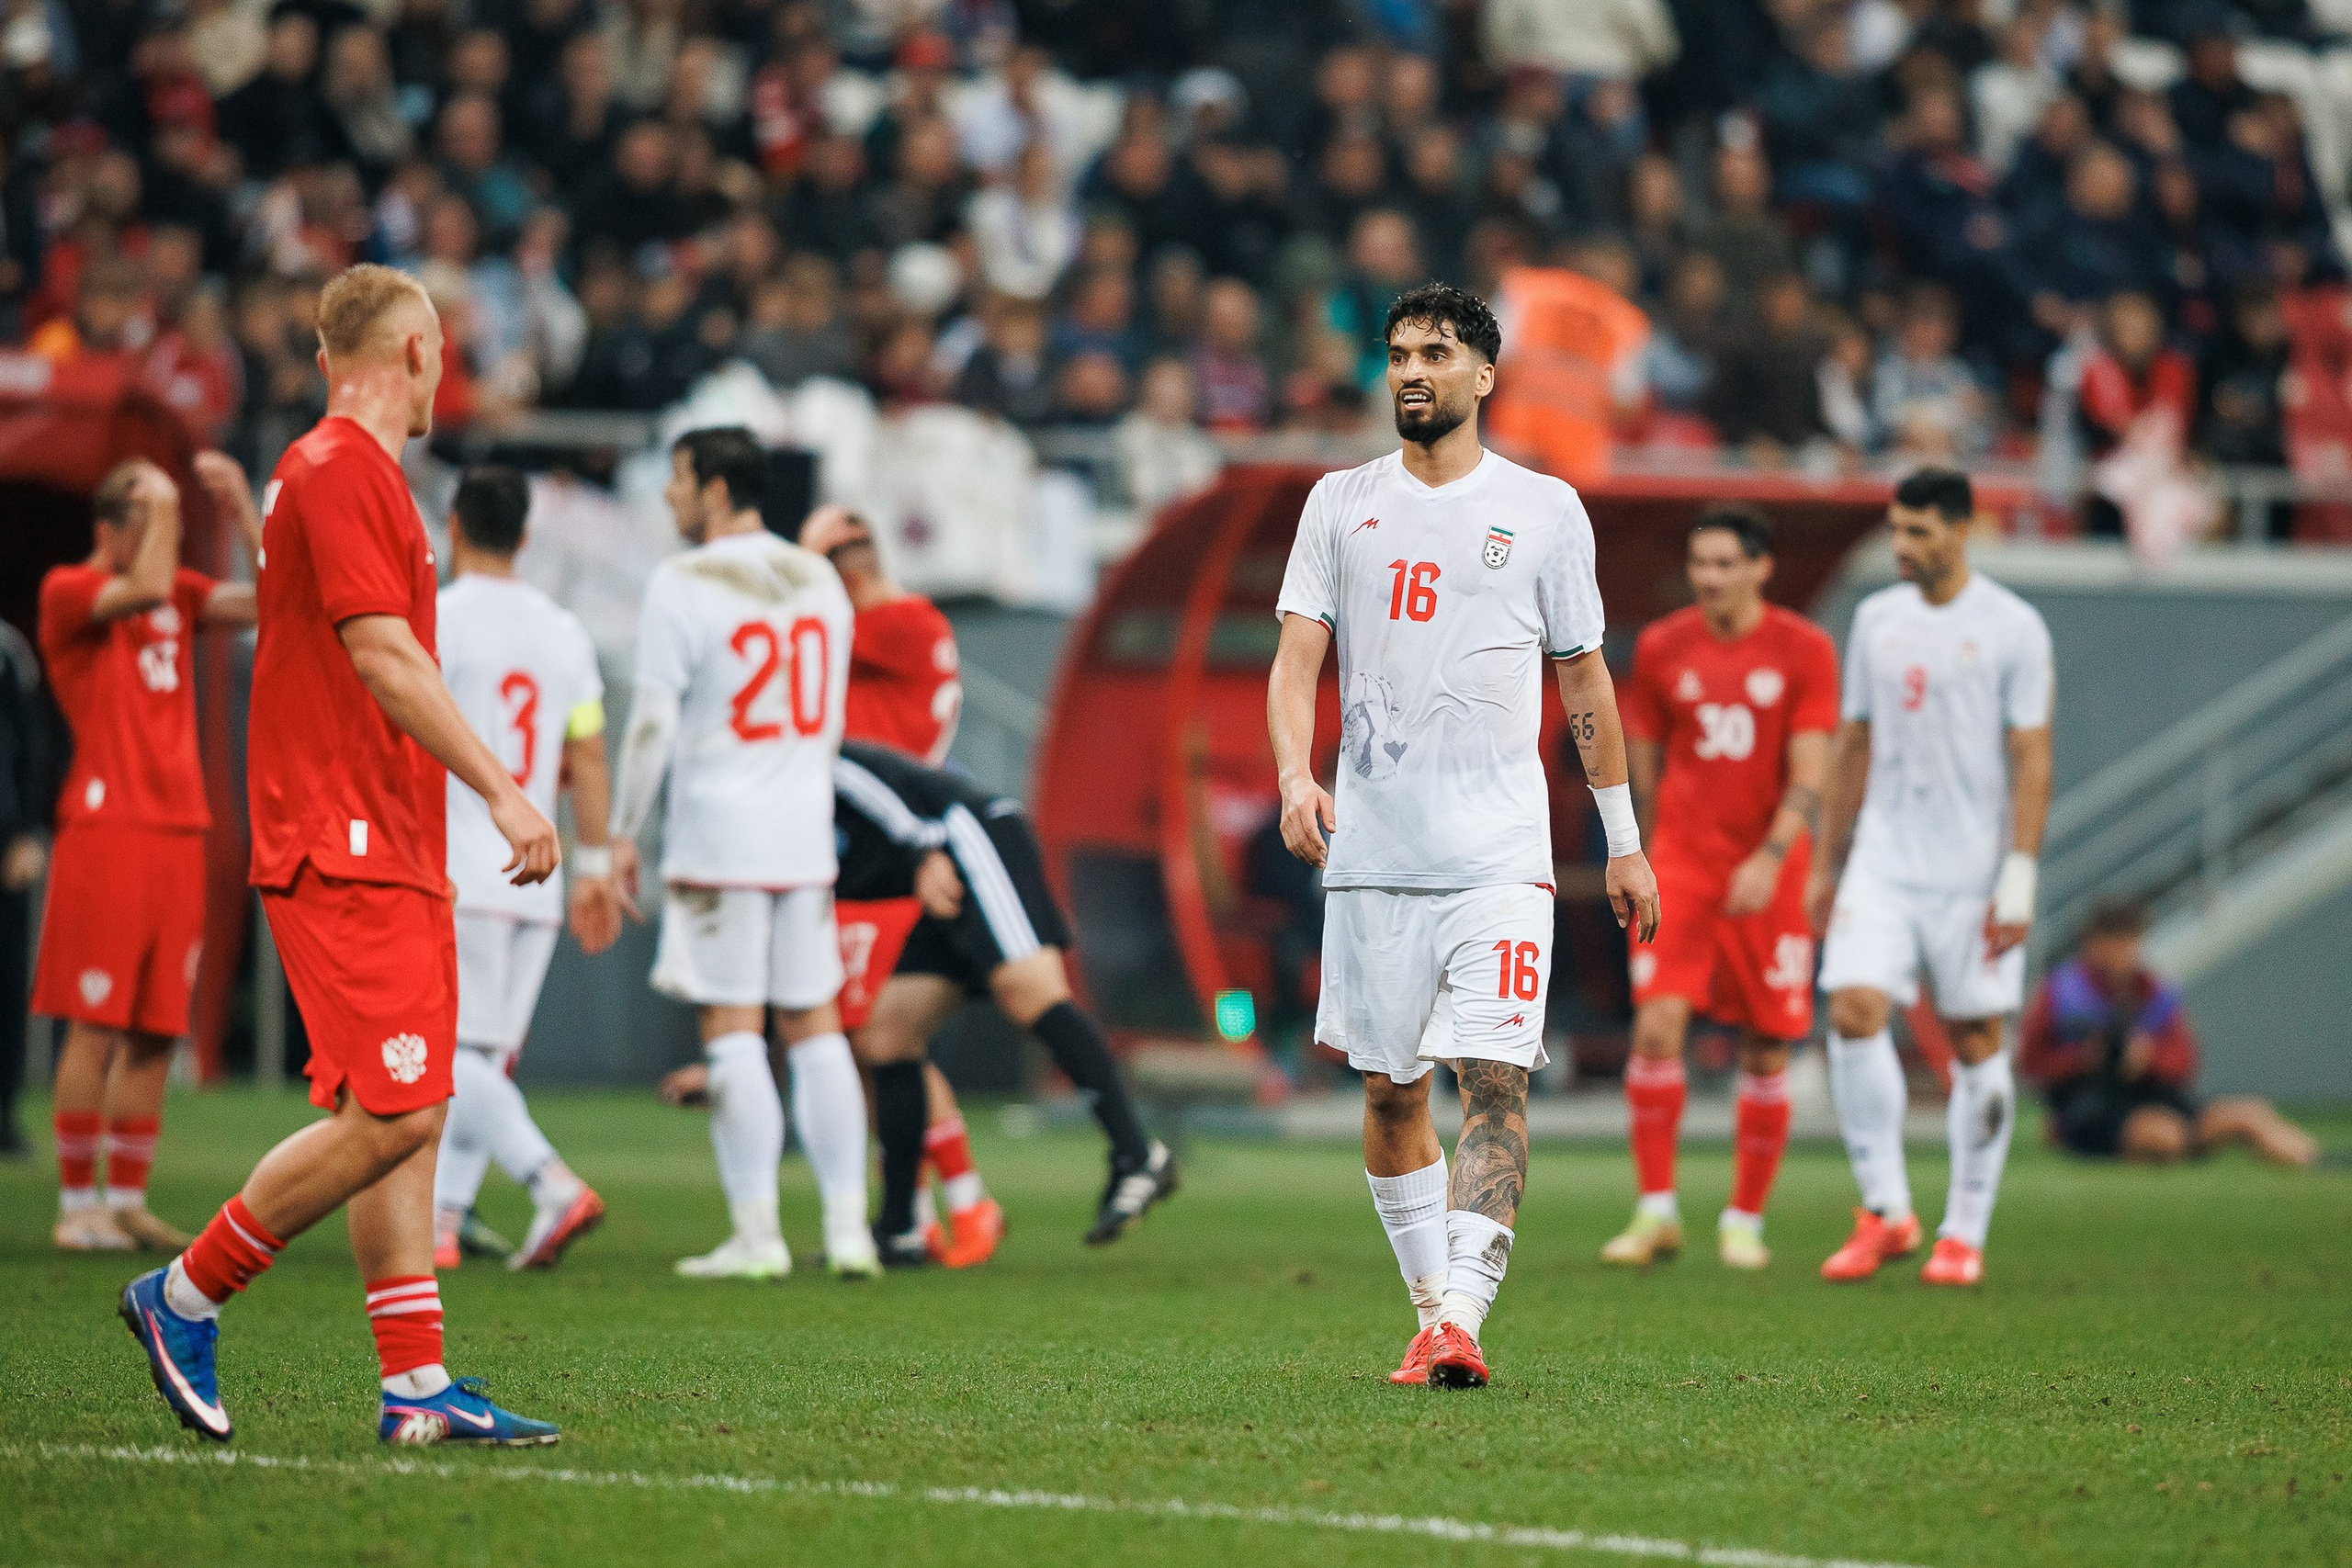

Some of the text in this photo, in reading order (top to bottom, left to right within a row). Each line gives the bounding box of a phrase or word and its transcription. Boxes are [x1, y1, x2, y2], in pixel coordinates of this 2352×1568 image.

[1387, 558, 1442, 623] 16
[729, 617, 829, 741] 20
[1901, 664, 1926, 712] 9
[501, 671, 538, 790] 3
[1695, 704, 1755, 761] 30
[1492, 940, 1540, 1002] 16
